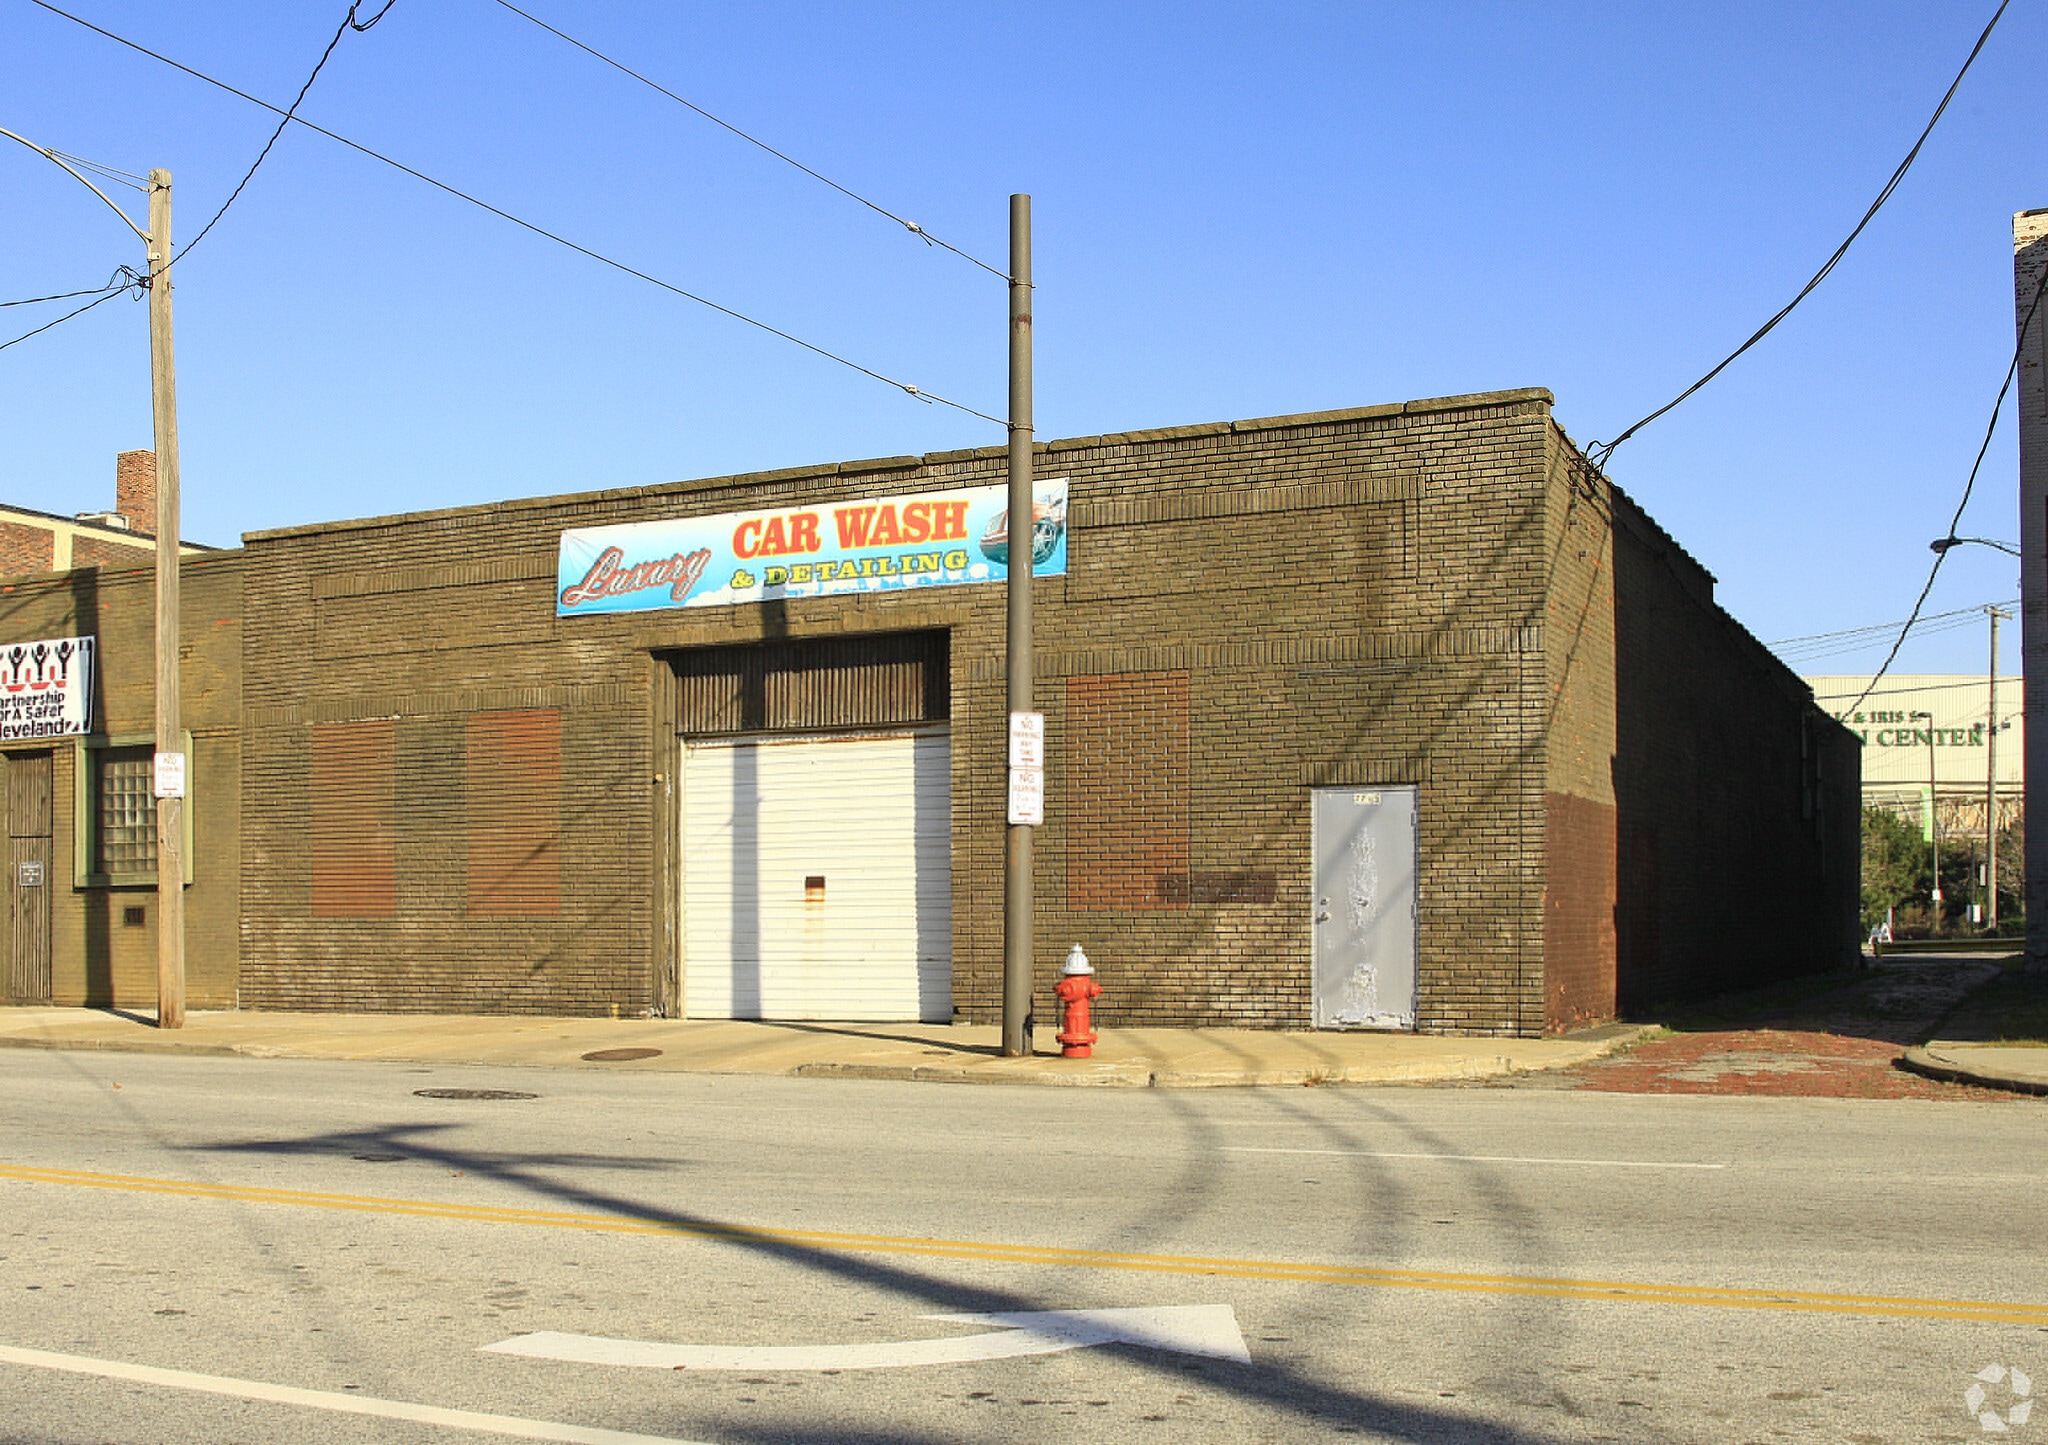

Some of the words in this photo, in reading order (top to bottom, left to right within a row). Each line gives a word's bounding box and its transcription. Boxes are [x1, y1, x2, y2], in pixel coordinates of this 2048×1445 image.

[731, 511, 821, 560] CAR
[832, 499, 969, 550] WASH
[561, 545, 712, 607] Luxury
[730, 568, 755, 589] &
[764, 550, 969, 586] DETAILING
[26, 704, 65, 720] Safer
[1853, 711, 1864, 723] &
[1870, 711, 1904, 723] IRIS
[1877, 728, 1984, 747] CENTER
